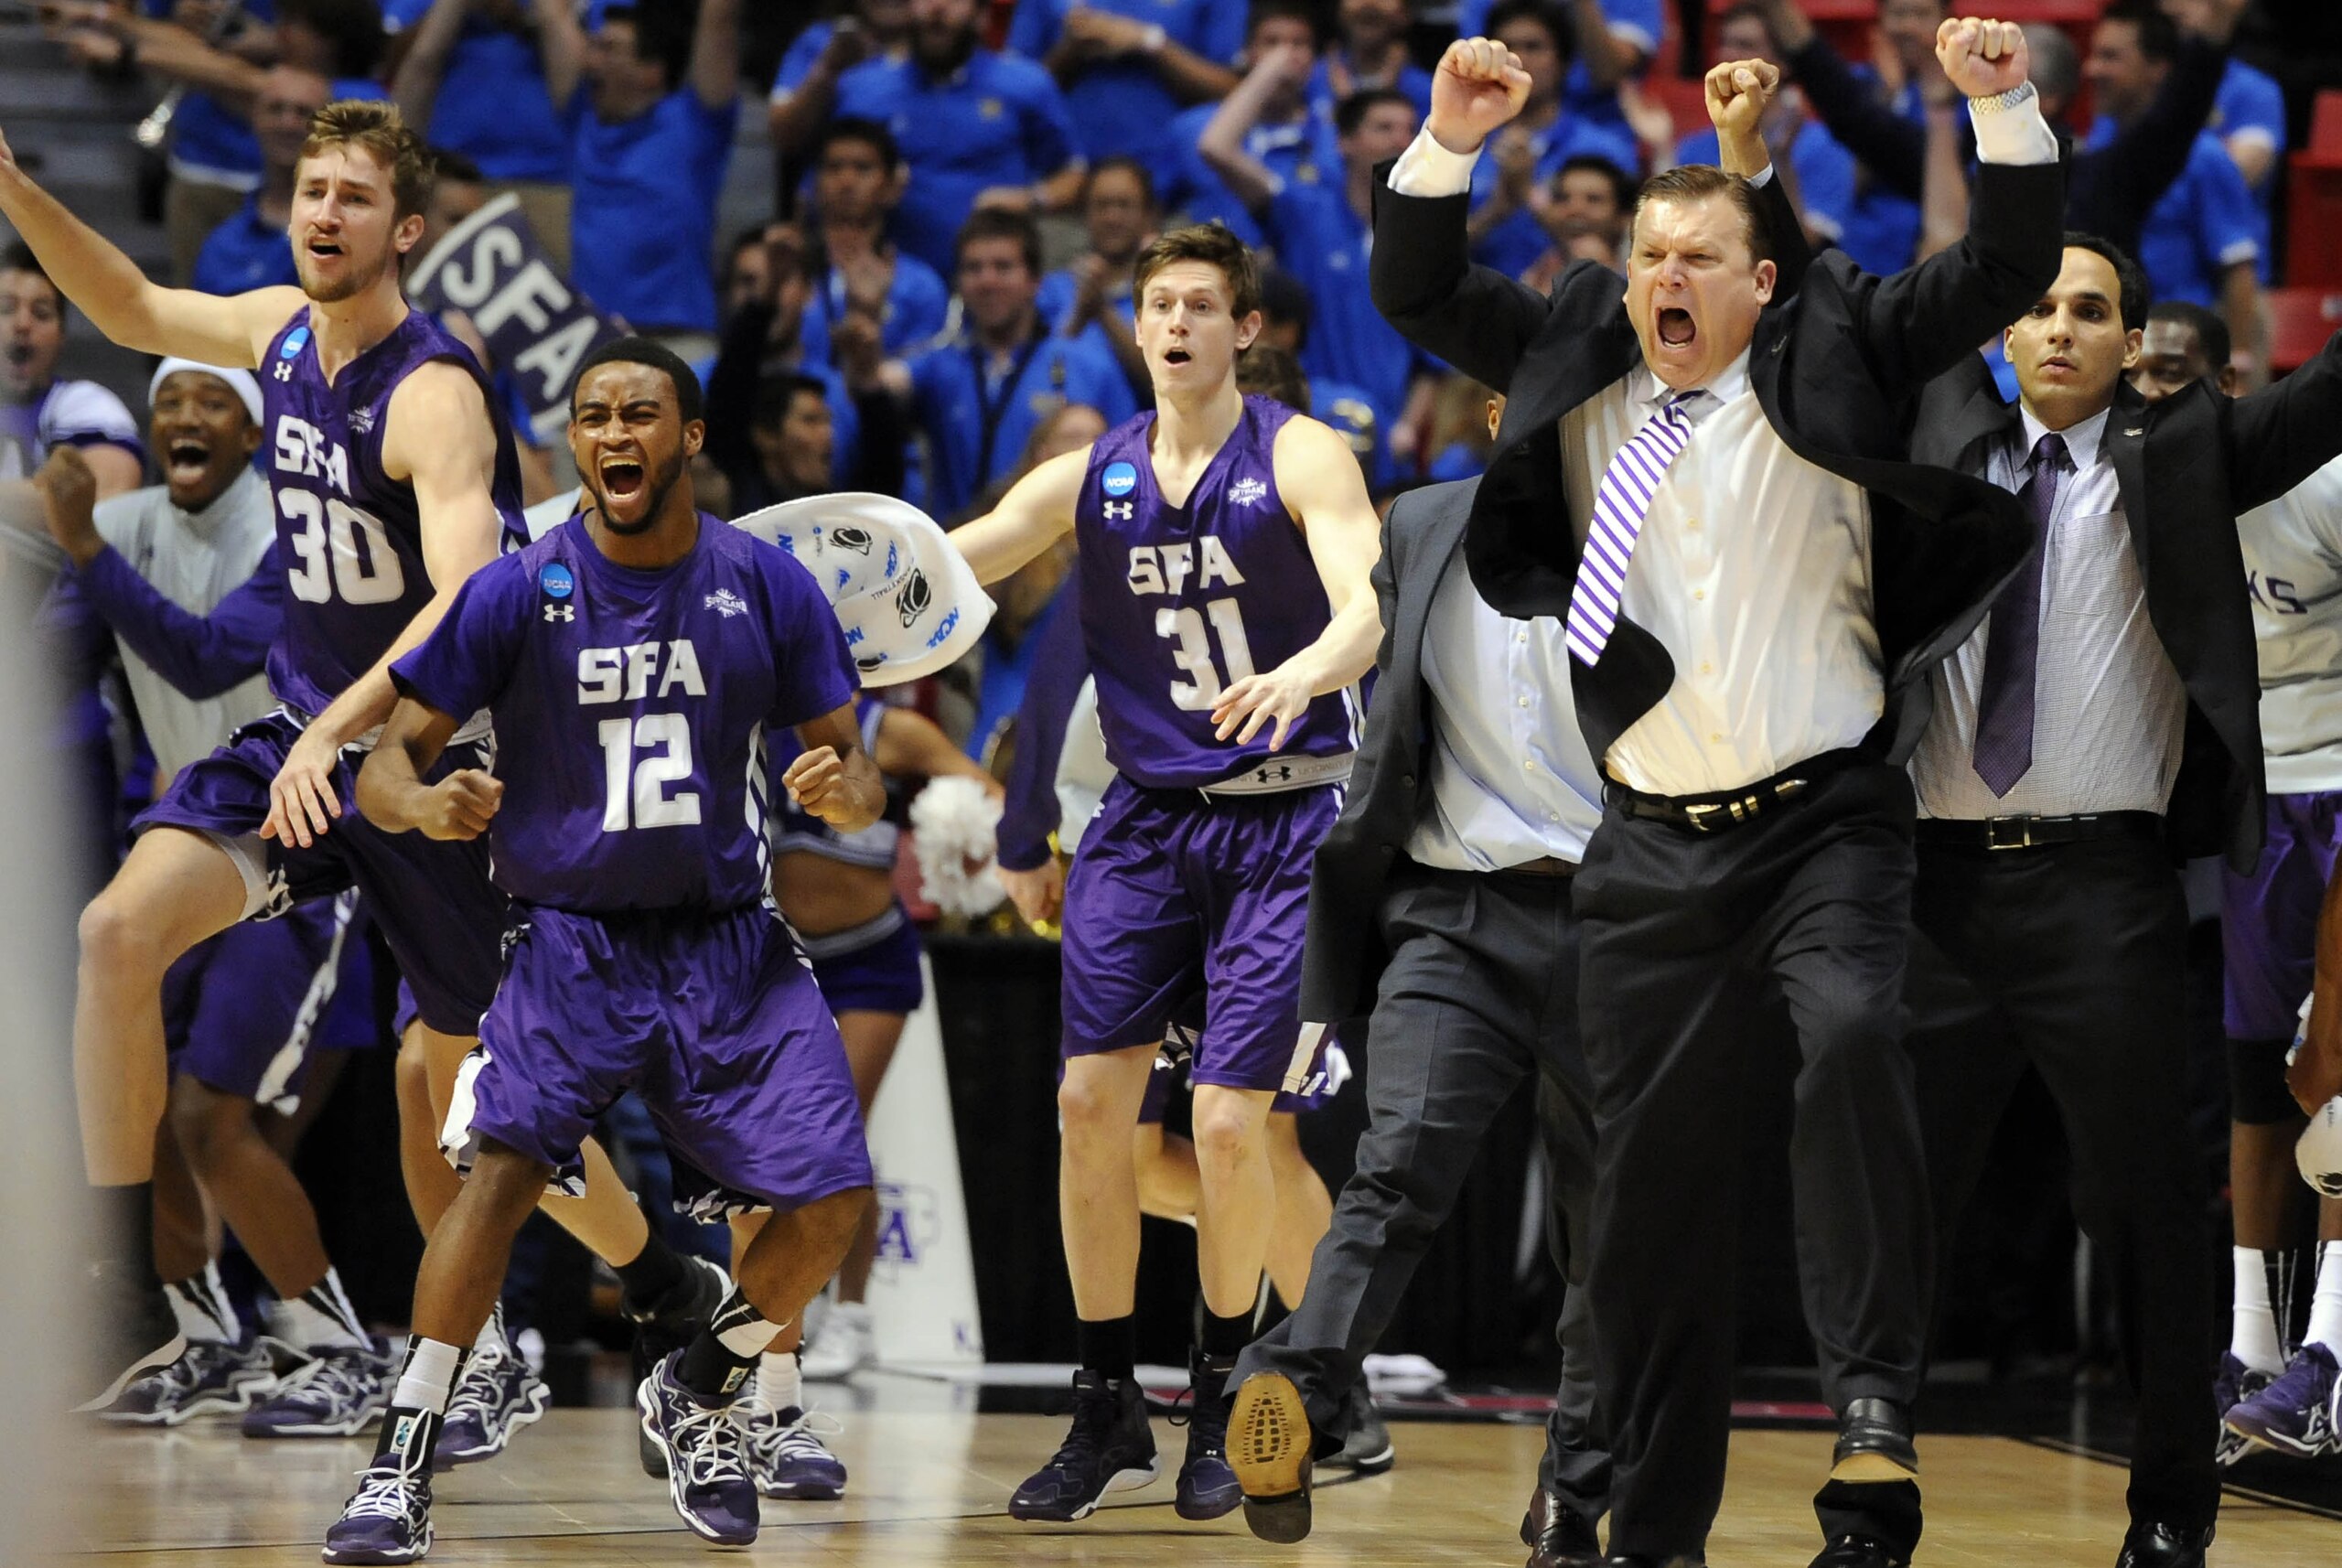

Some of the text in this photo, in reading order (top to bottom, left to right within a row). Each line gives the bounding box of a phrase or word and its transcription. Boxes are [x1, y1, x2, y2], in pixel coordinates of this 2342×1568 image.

[441, 225, 600, 401] SFA
[274, 414, 352, 499] SFA
[277, 487, 405, 605] 30
[1126, 534, 1246, 596] SFA
[577, 639, 707, 705] SFA
[1155, 596, 1256, 711] 31
[597, 712, 702, 832] 12
